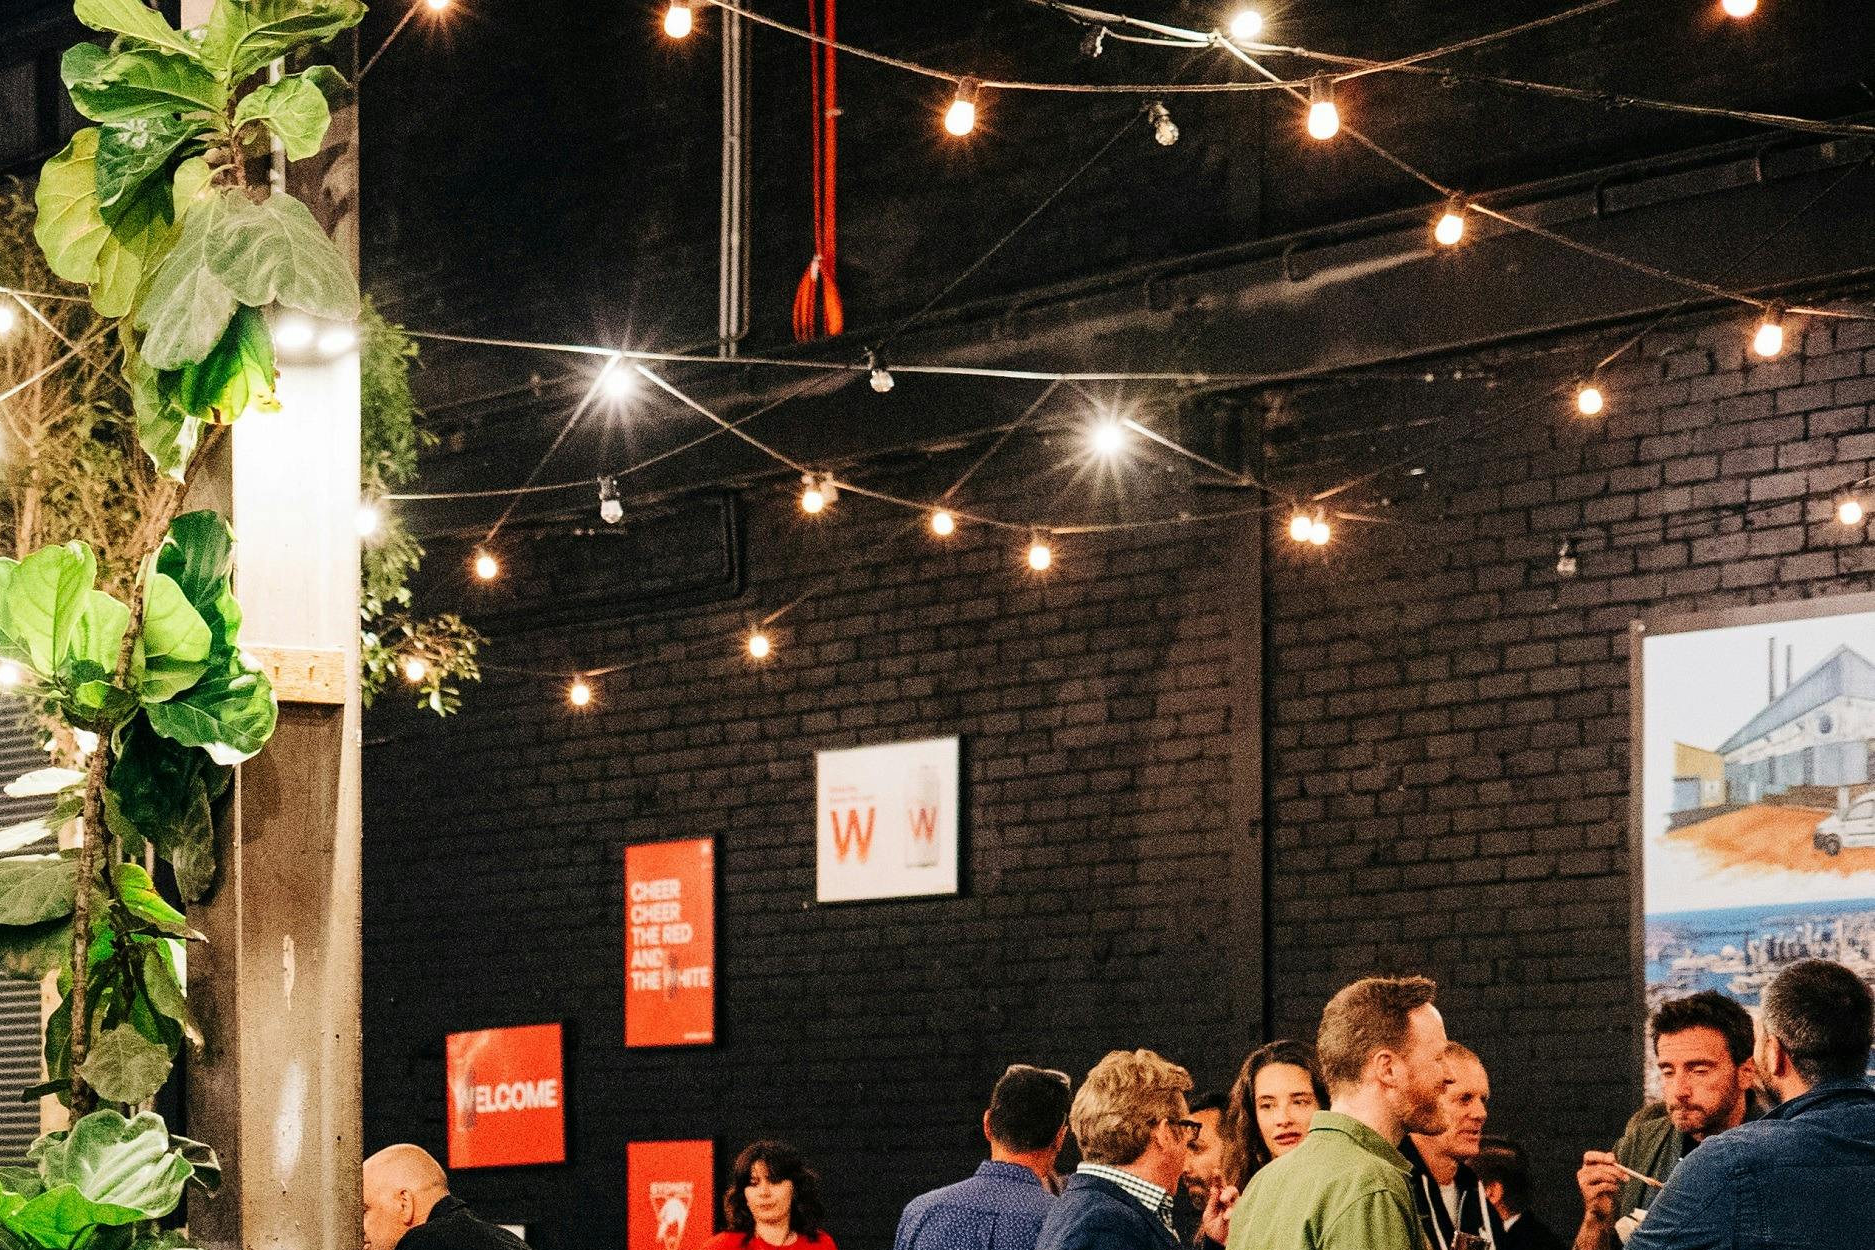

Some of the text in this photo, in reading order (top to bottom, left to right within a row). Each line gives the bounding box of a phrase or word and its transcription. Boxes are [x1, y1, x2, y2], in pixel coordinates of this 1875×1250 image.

[829, 806, 876, 865] W
[630, 878, 682, 902] CHEER
[630, 901, 681, 925] CHEER
[630, 922, 693, 947] THE RED
[630, 970, 662, 992] THE
